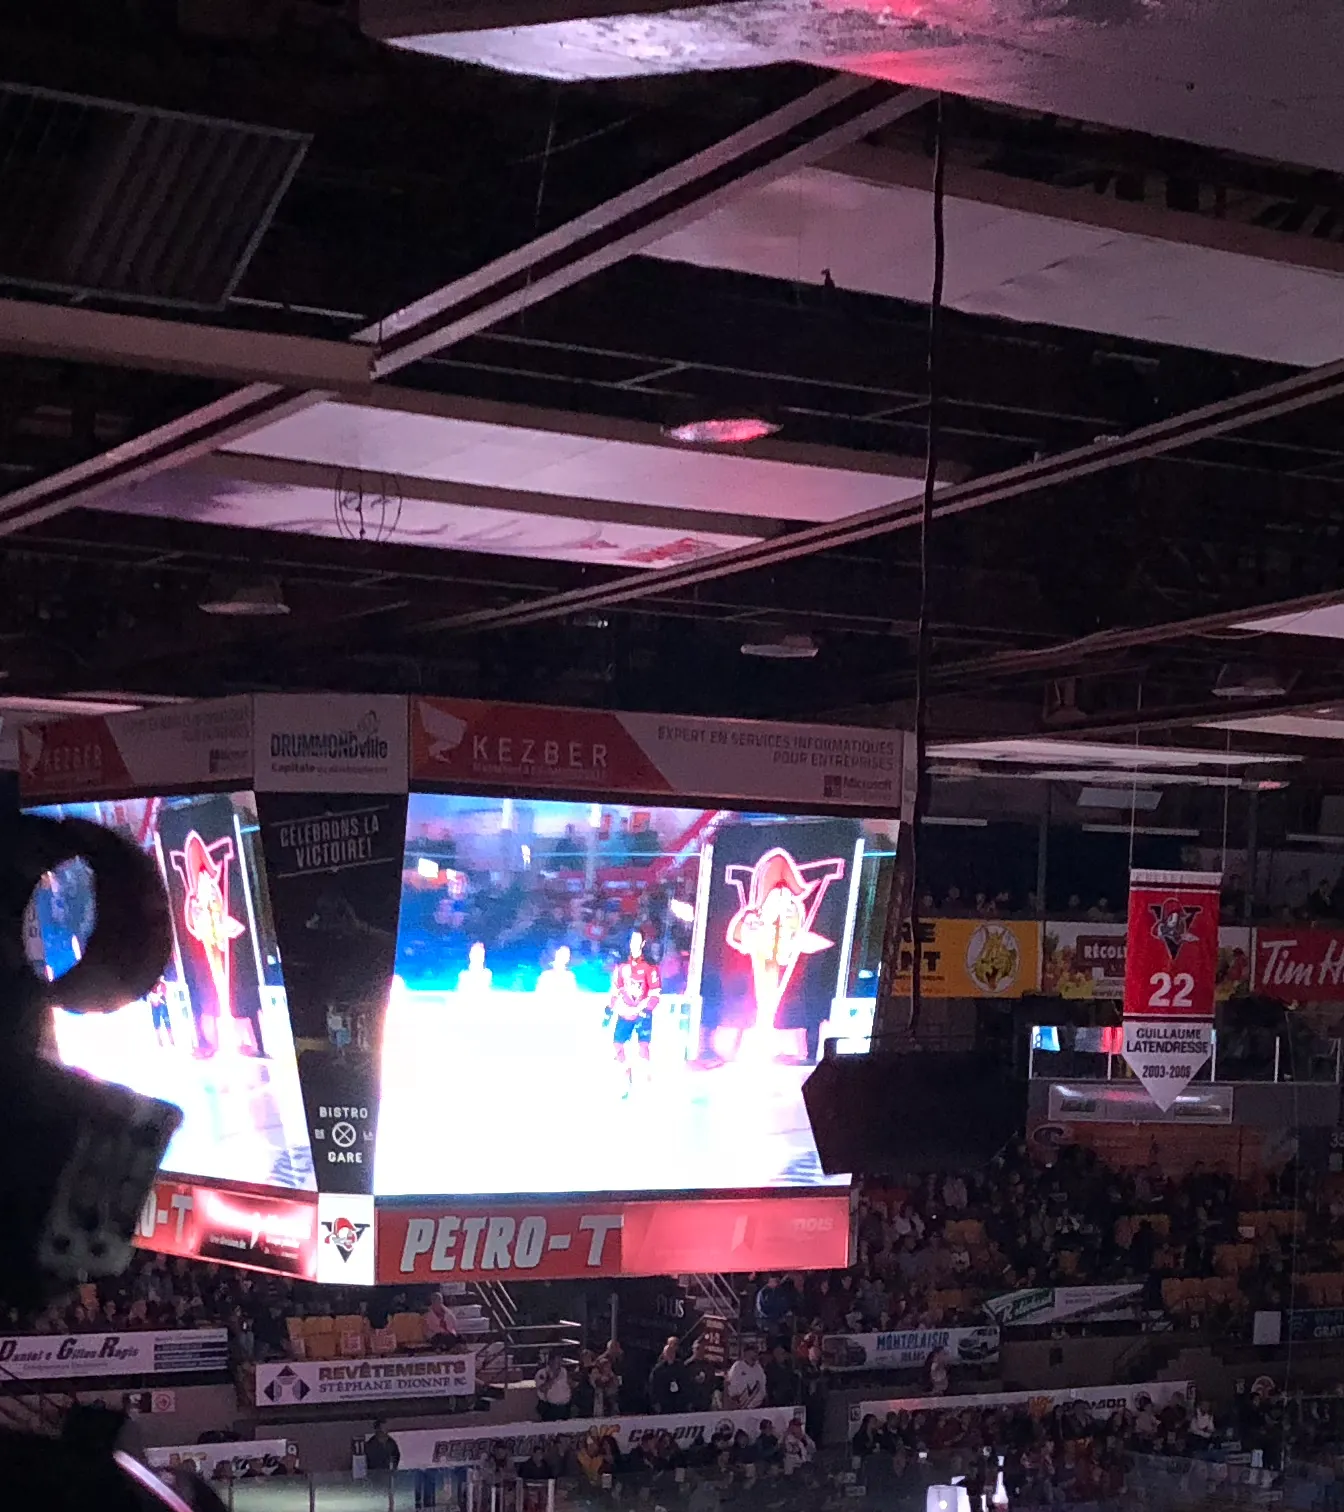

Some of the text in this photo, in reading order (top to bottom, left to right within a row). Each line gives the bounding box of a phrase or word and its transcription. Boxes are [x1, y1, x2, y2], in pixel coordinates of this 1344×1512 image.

[472, 734, 608, 769] KEZBER
[362, 814, 380, 836] LA
[1261, 939, 1313, 987] Tim
[1147, 972, 1196, 1008] 22
[1136, 1028, 1201, 1040] GUILLAUME
[1126, 1040, 1209, 1054] LATENDRESSE
[318, 1106, 369, 1120] BISTRO
[327, 1151, 363, 1164] GARE
[318, 1360, 466, 1381] REVÊTEMENTS
[397, 1377, 450, 1390] DIONNE
